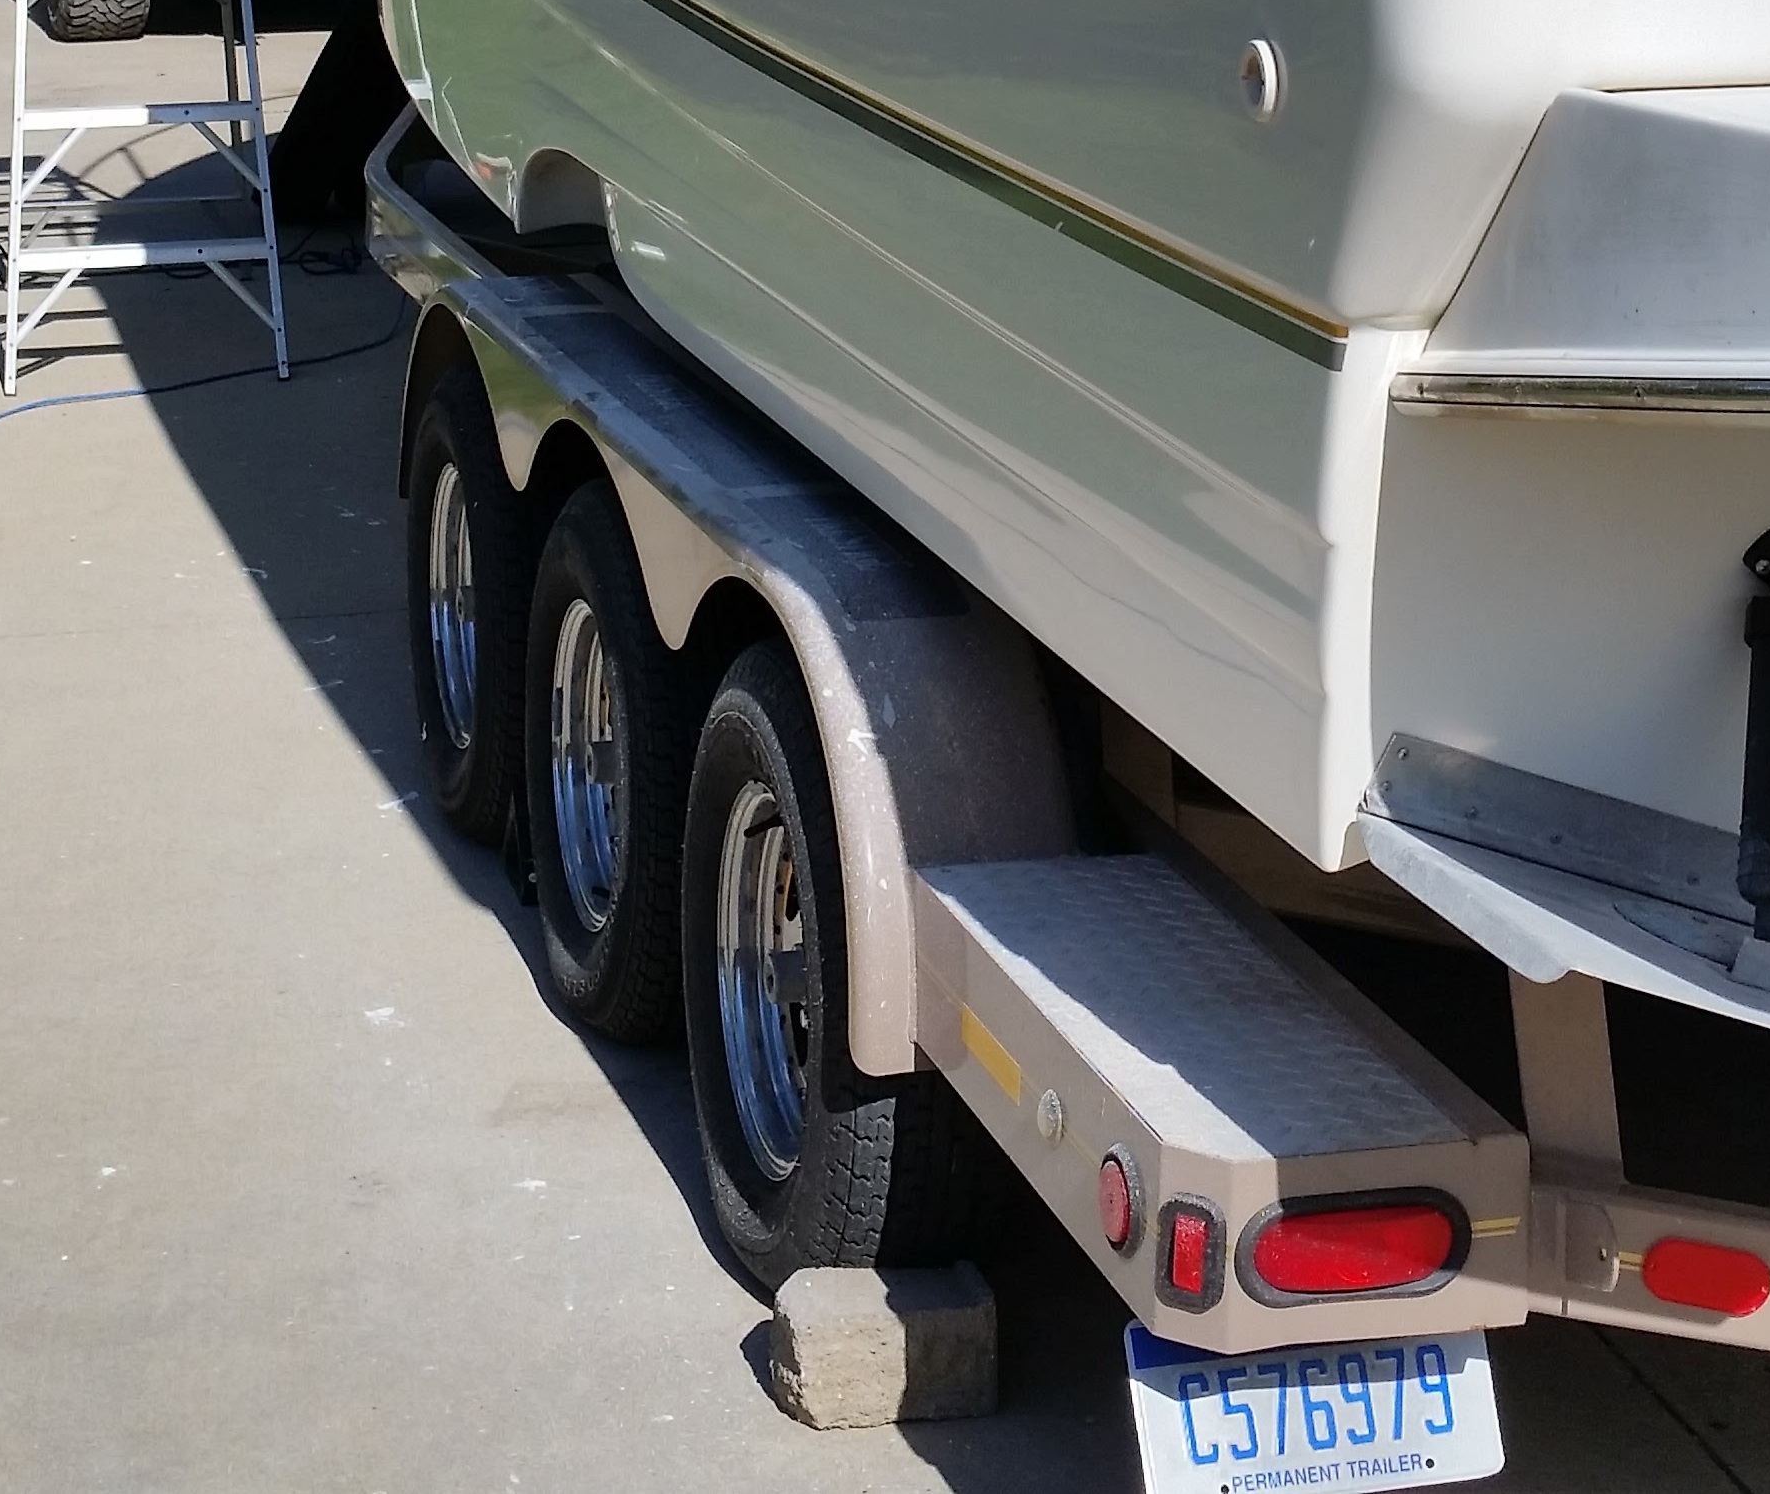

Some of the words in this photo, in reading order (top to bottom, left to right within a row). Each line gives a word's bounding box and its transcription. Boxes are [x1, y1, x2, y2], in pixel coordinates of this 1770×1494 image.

[1178, 1343, 1455, 1466] C576979
[1232, 1465, 1341, 1494] PERMANENT
[1346, 1452, 1423, 1479] TRAILER
